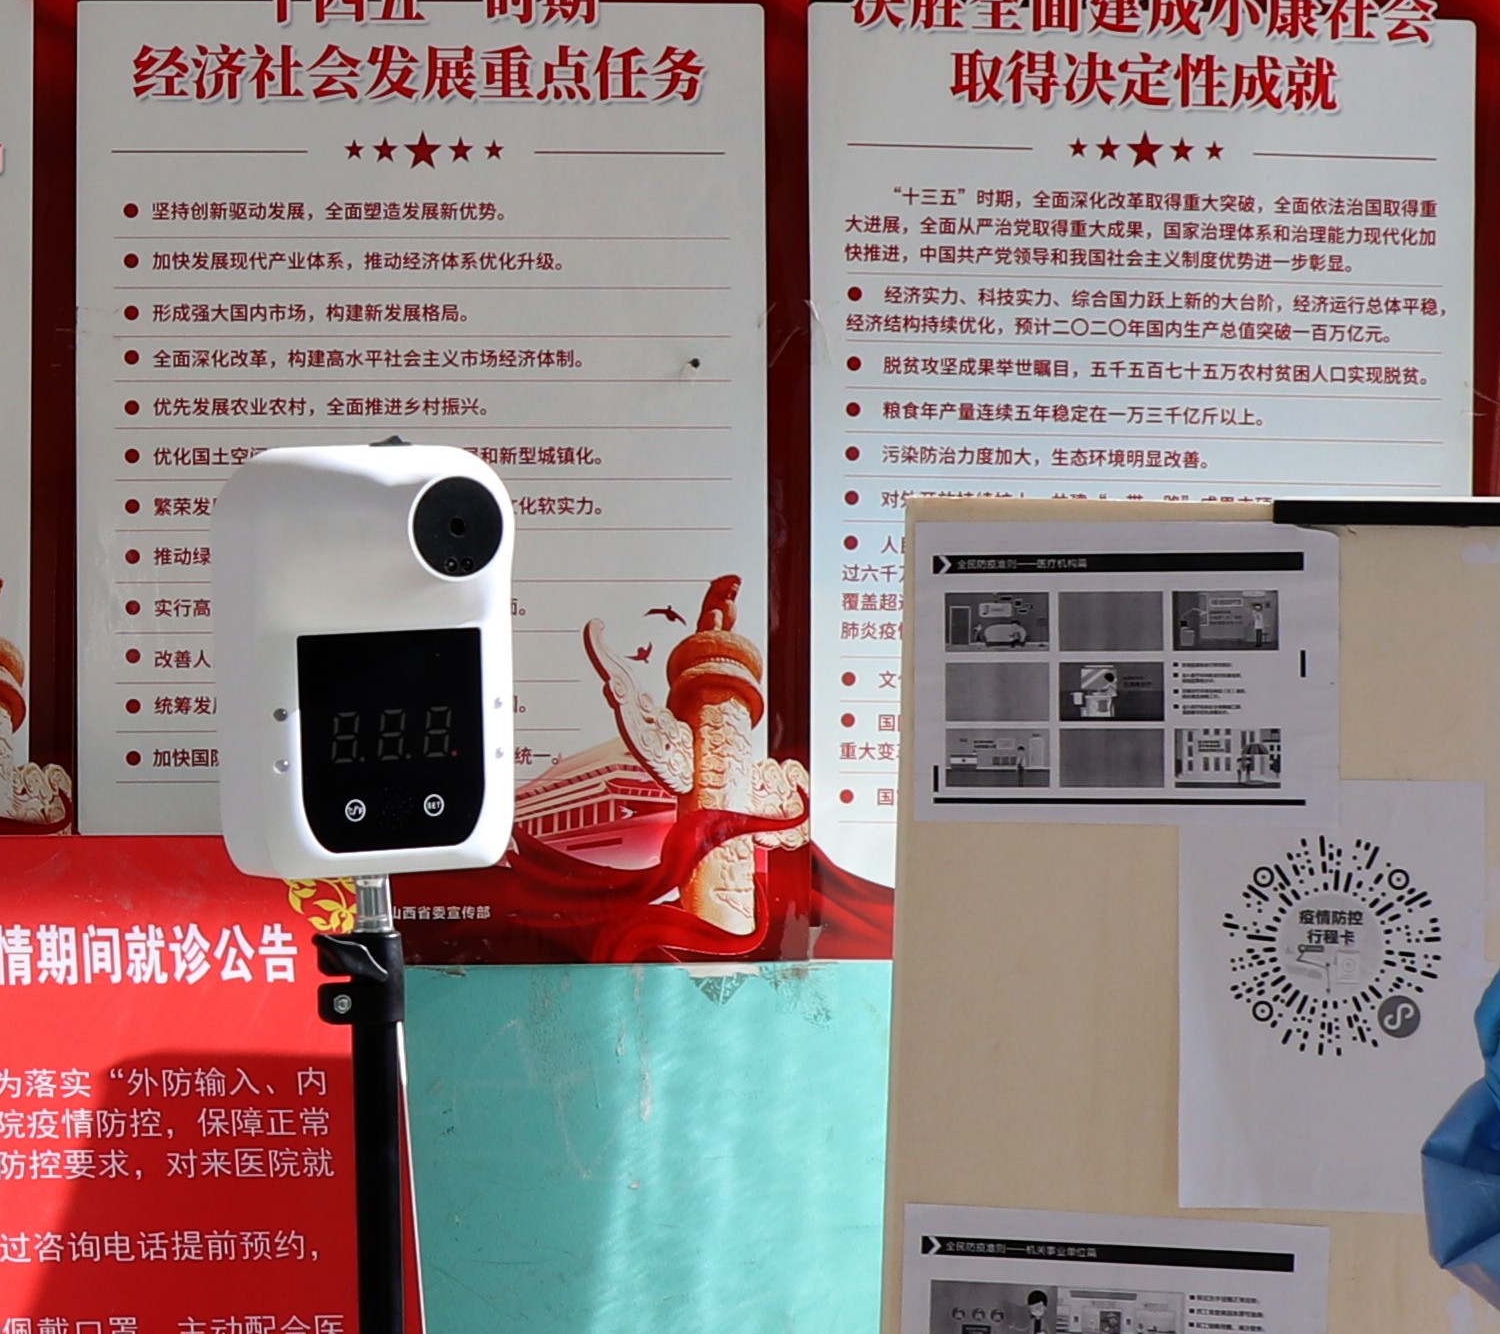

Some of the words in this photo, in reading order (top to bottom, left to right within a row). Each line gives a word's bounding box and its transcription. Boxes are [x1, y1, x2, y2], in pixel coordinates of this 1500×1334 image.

[133, 44, 704, 100] 经济社会发展重点任务
[950, 49, 1337, 110] 取得决定性成就
[153, 203, 504, 220] 坚持创新驱动发展，全面塑造发展新优势。
[153, 251, 562, 271] 加快发展现代产业体系，推动经济体系优化升级。
[153, 304, 466, 322] 形成强大国内市场，构建新发展格局。
[154, 349, 582, 368] 全面深化改革，构建高水平社会主义市场经济体制。
[154, 398, 486, 415] 优先发展农业农村，全面推进乡村振兴。
[1299, 909, 1363, 925] 疫情防控
[1307, 927, 1354, 944] 行程卡
